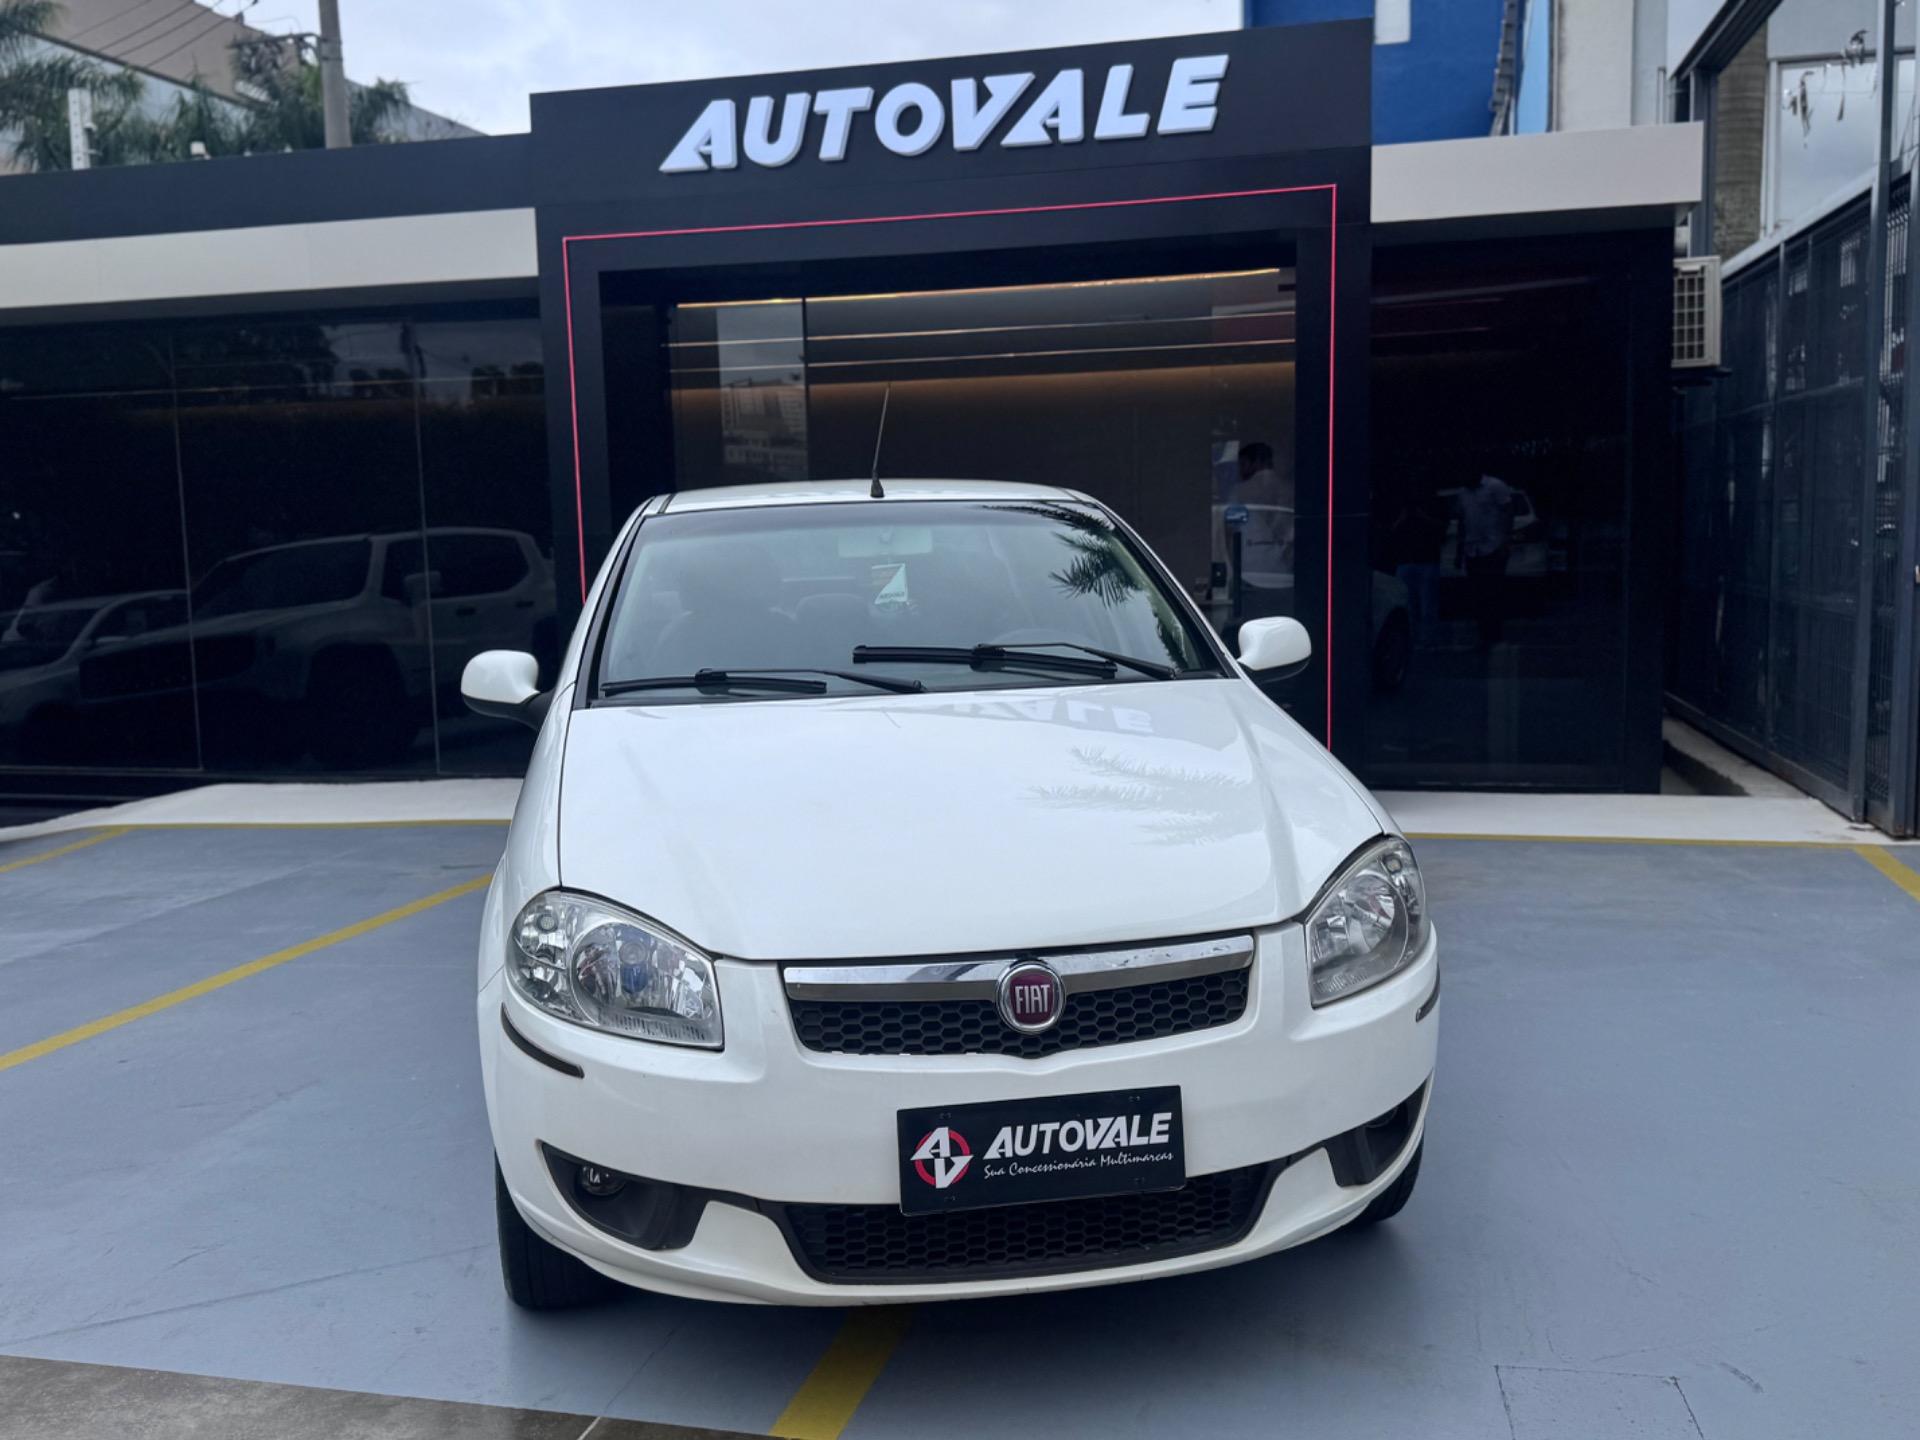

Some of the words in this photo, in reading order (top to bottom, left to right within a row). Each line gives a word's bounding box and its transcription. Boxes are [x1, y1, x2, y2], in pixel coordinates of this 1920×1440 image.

[658, 53, 1230, 174] AUTOVALE
[1014, 984, 1051, 1015] FIAT
[982, 1112, 1173, 1160] AUTOVALE
[983, 1164, 1006, 1180] Sua
[1008, 1157, 1097, 1176] Concessionária
[1100, 1150, 1175, 1168] Multimarcas
